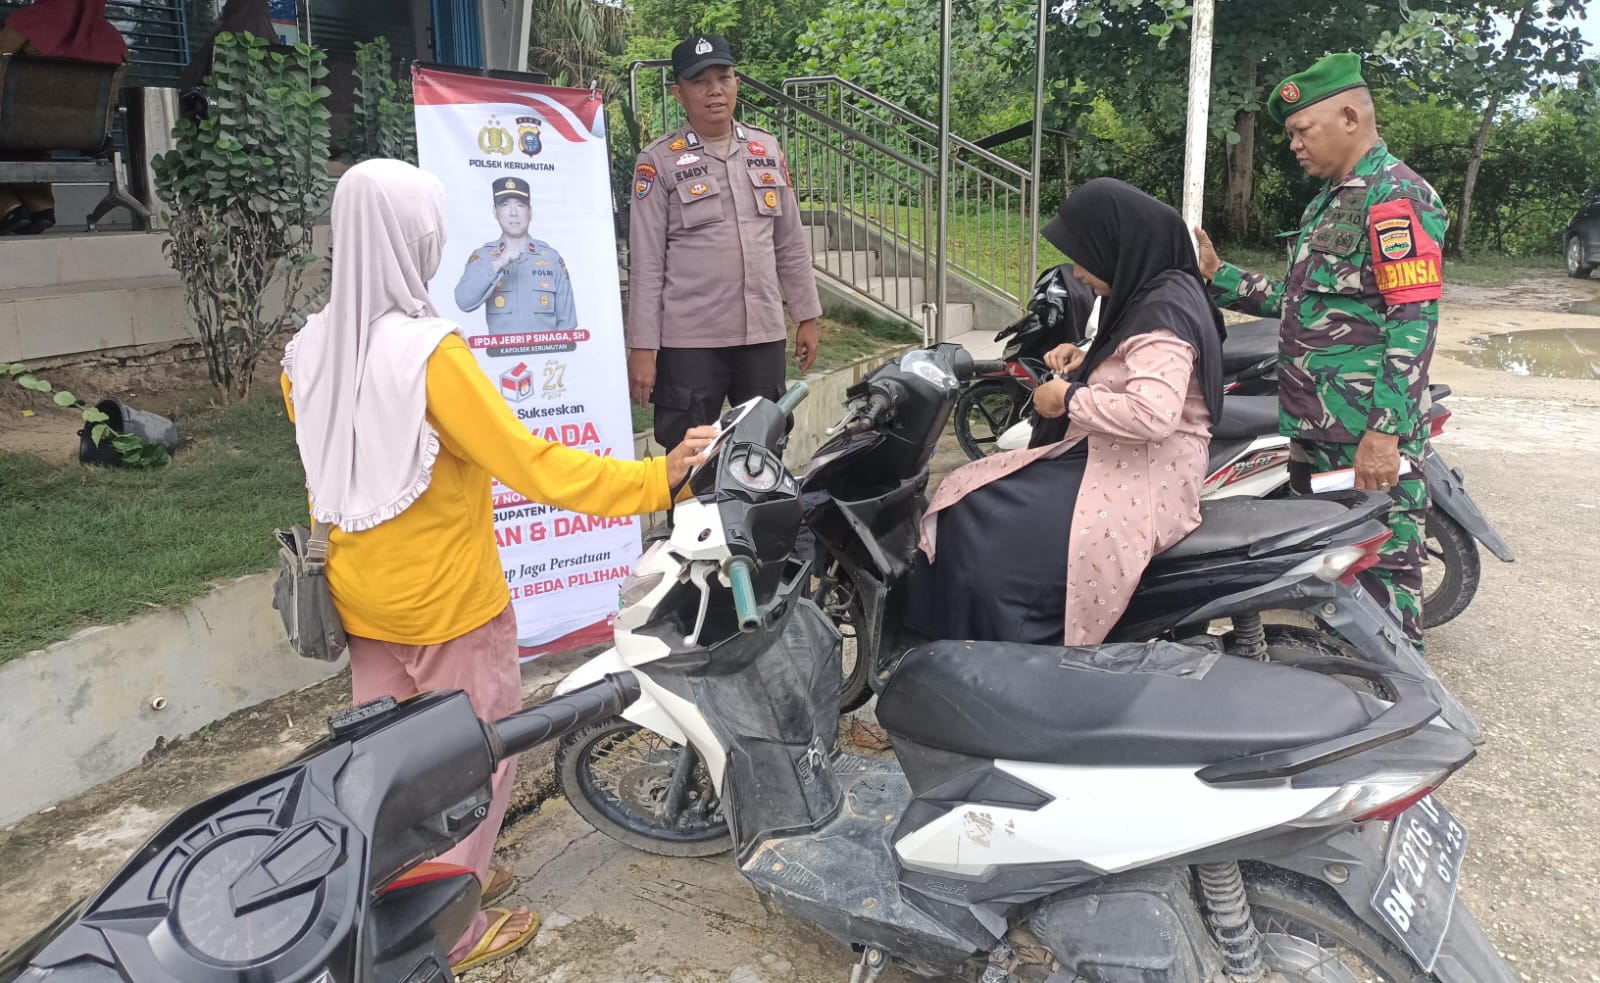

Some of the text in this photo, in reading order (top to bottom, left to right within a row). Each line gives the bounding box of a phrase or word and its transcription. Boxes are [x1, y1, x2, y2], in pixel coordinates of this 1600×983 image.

[469, 159, 555, 171] POLSEK KERUMUTAN
[746, 158, 776, 167] POLRI
[675, 165, 708, 181] EMDY
[474, 331, 585, 347] IPDA JERRI P SINAGA, SH
[531, 344, 568, 352] KERUMUTAN
[542, 364, 567, 391] 27
[517, 404, 585, 420] Sukseskan
[529, 522, 546, 541] &
[519, 562, 546, 578] Jaga
[550, 551, 611, 570] Persatuan
[524, 578, 564, 597] BEDA
[568, 565, 630, 588] PILIHAN
[1398, 817, 1432, 889] 2276
[1382, 877, 1417, 933] BM
